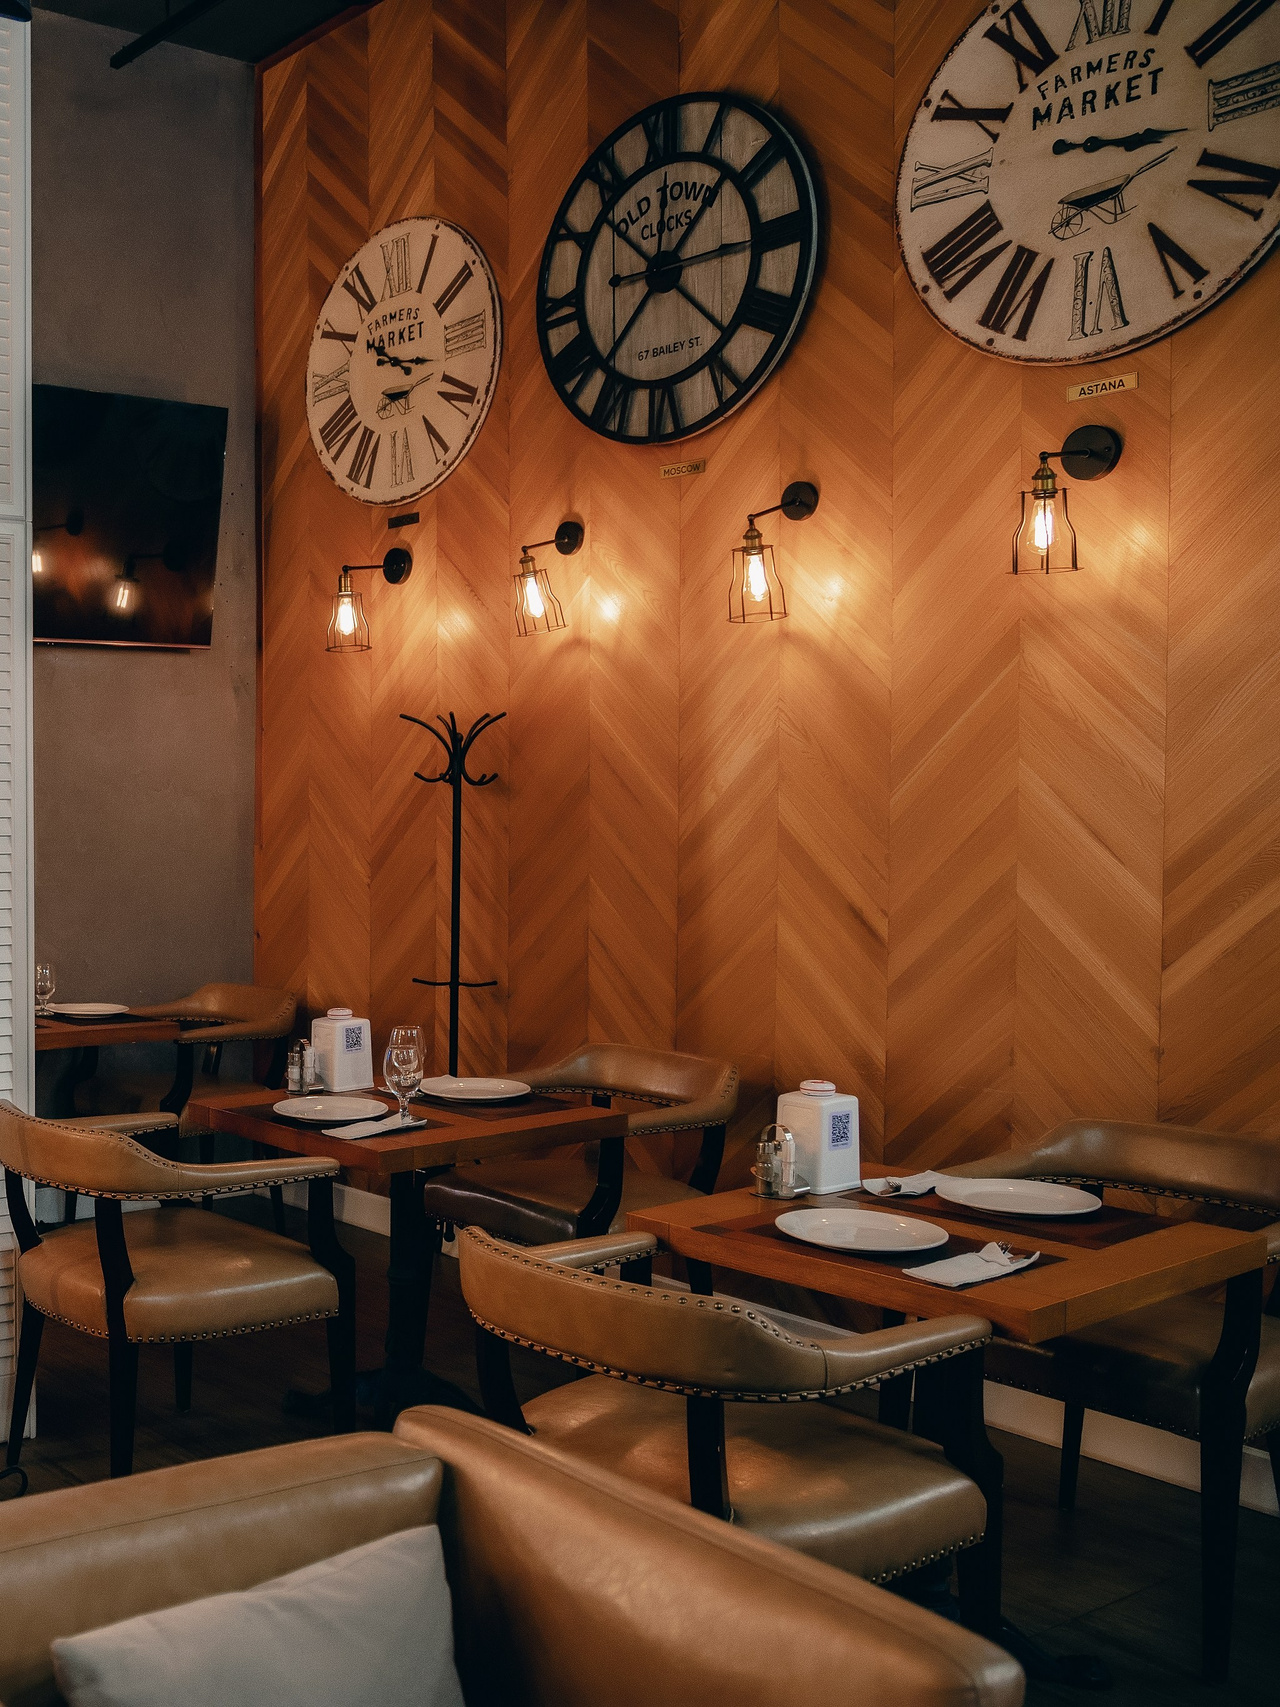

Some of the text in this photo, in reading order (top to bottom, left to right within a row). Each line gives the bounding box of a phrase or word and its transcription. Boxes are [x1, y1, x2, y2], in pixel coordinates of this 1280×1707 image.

[1032, 67, 1164, 131] MARKET
[1037, 48, 1156, 101] FARMERS
[931, 89, 1014, 144] X
[616, 196, 651, 238] OLD
[641, 209, 693, 241] CLOCKS
[380, 232, 413, 302] XII
[1147, 221, 1210, 299] V
[341, 261, 378, 324] XI
[1068, 246, 1130, 341] VI
[320, 318, 359, 357] X
[366, 320, 424, 354] MARKET
[367, 307, 420, 336] FARMERS
[637, 350, 650, 361] 67
[652, 340, 686, 358] BAILEY
[1078, 379, 1126, 397] ASTANA
[390, 427, 415, 488] VI
[422, 414, 451, 465] V
[663, 463, 701, 477] MOSCOW
